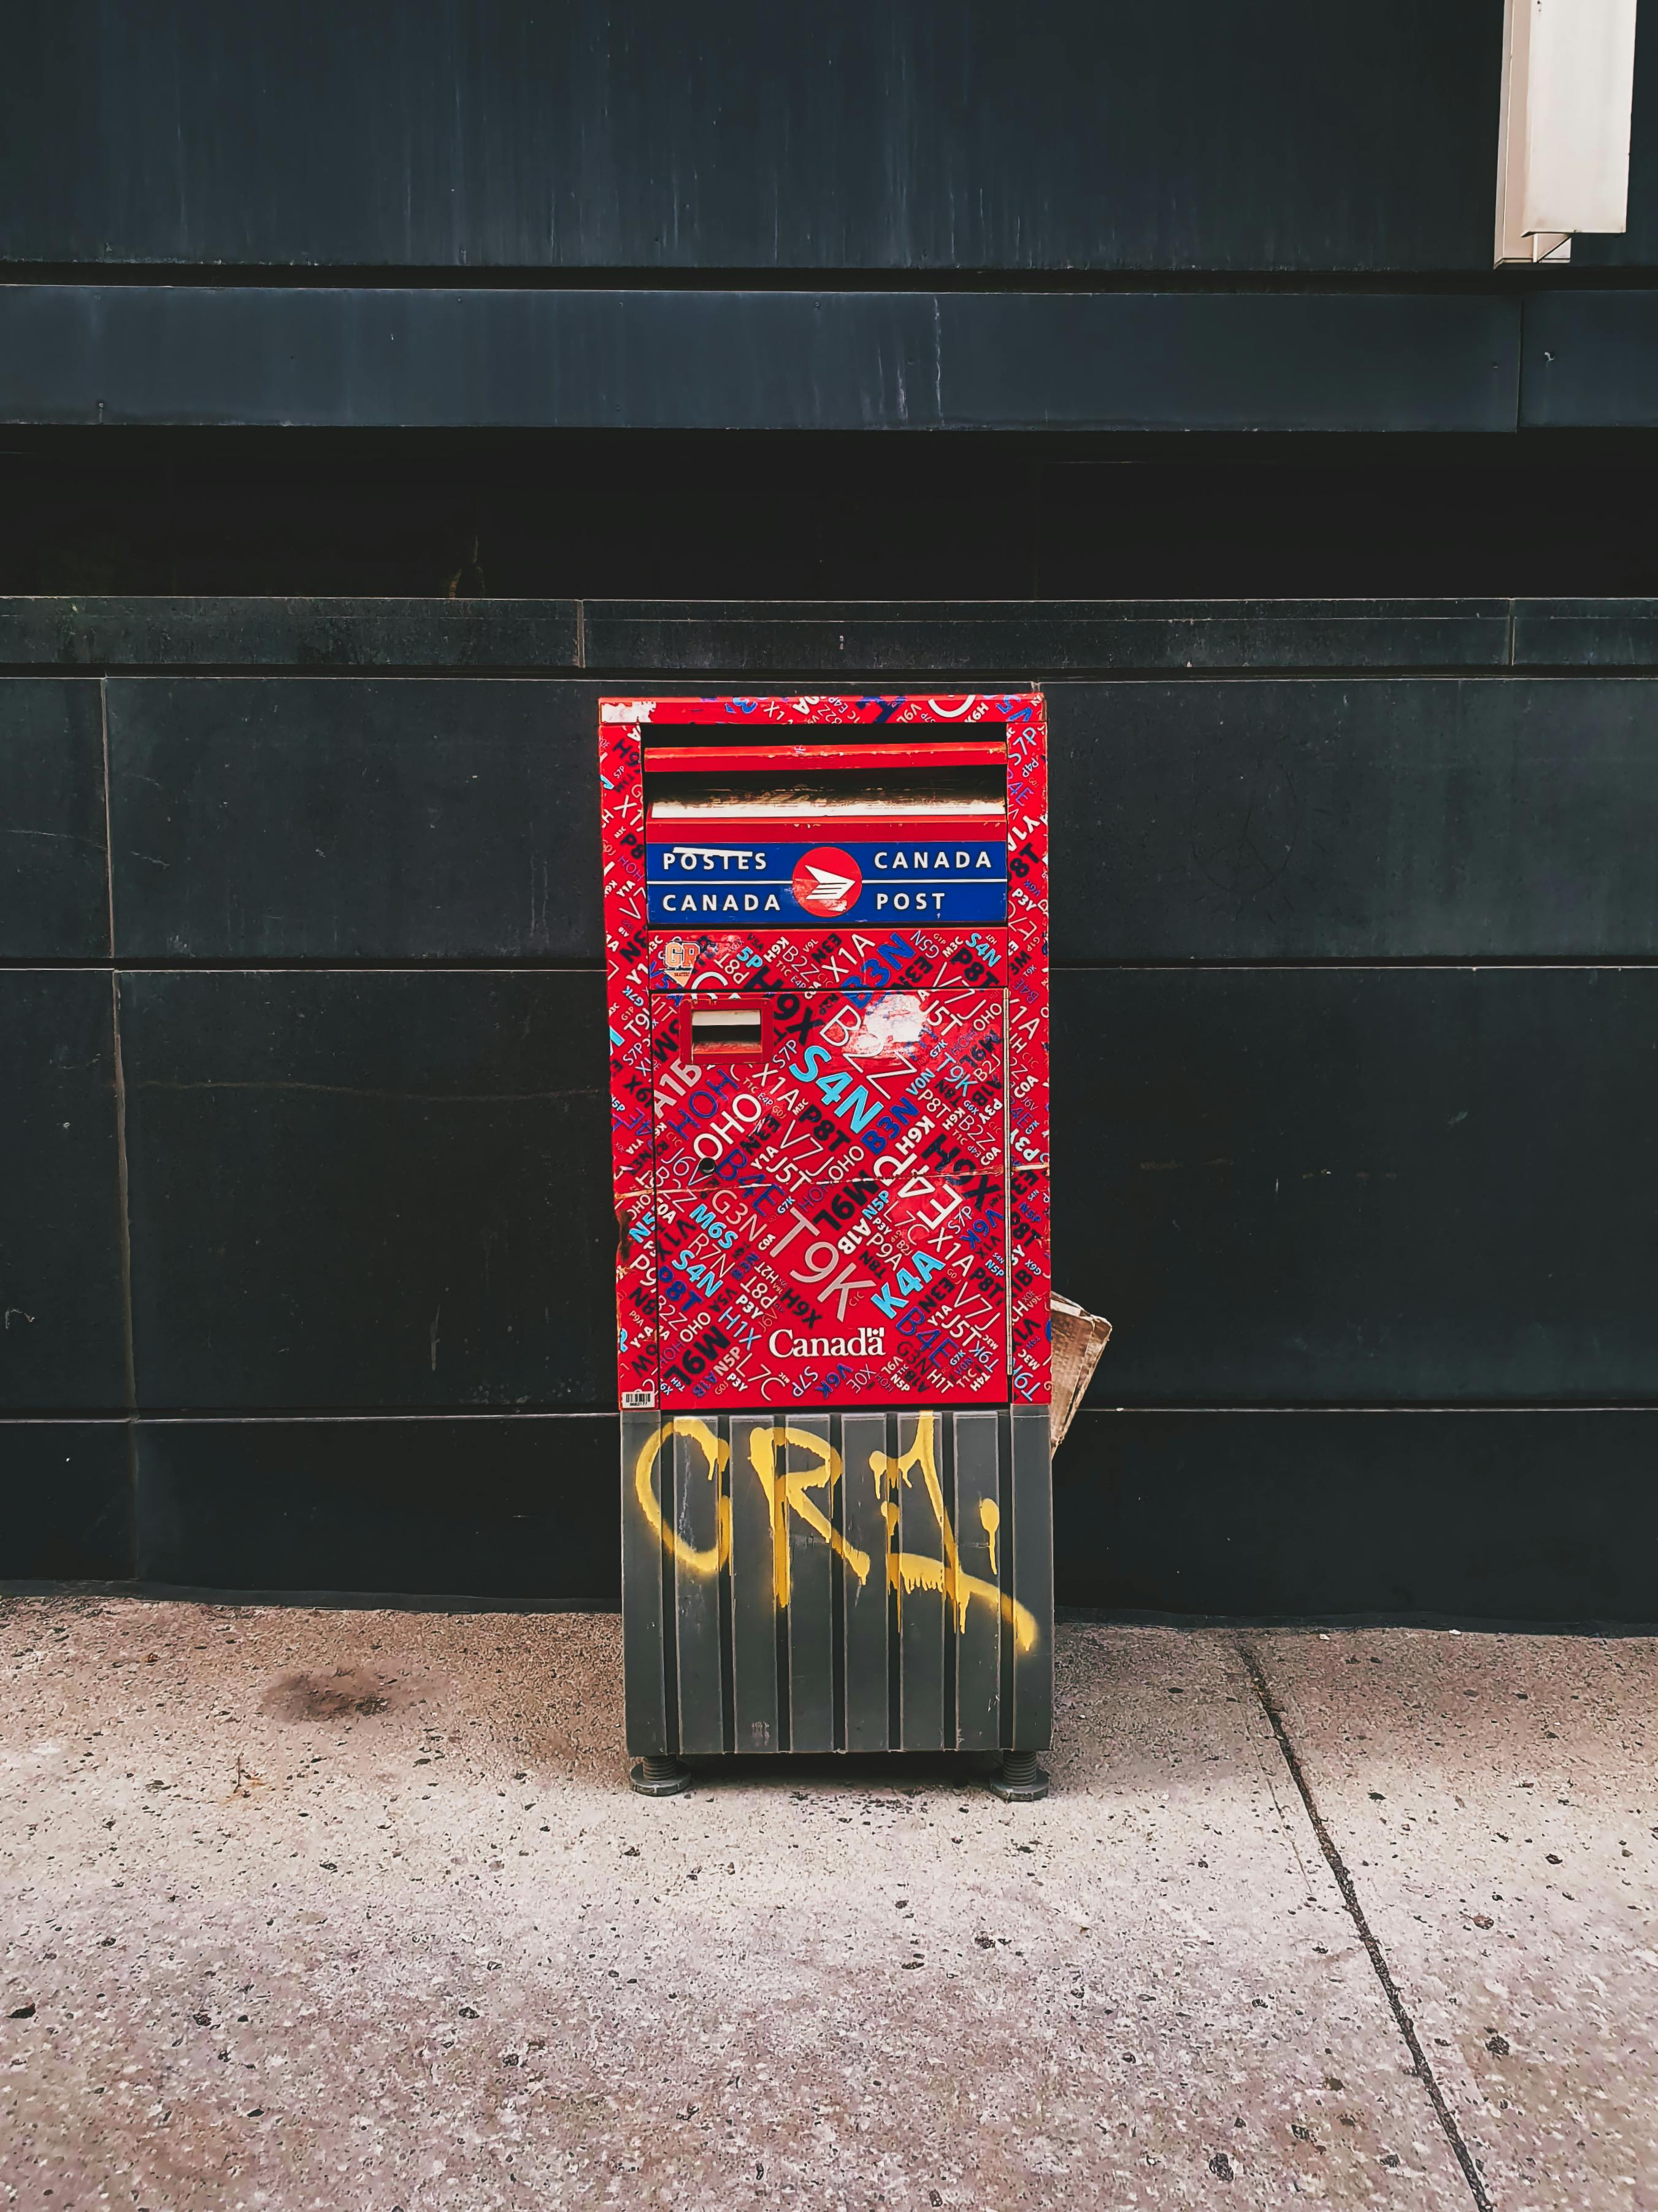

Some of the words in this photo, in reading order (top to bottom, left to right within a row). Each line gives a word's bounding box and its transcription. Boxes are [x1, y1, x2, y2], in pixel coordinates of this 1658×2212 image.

[613, 766, 625, 779] S7P
[663, 851, 766, 870] POSTES
[874, 851, 991, 869] CANADA
[662, 894, 780, 912] CANADA
[877, 893, 945, 910] POST
[1011, 888, 1038, 912] P3Y
[763, 936, 790, 962] K6H
[821, 933, 876, 983] X1A
[942, 936, 964, 958] M3C
[965, 932, 1002, 967] S4N
[782, 945, 820, 982] B2Z
[623, 1042, 643, 1066] S7P
[772, 1040, 797, 1069] S7P
[973, 1053, 1001, 1082] B2J
[654, 1058, 702, 1119] A1B
[752, 1063, 799, 1111] X1A
[789, 1045, 884, 1134] S4N
[937, 1051, 978, 1097] T9K
[792, 1098, 809, 1116] M3C
[918, 1089, 951, 1118] P8T
[942, 1107, 965, 1131] K6H
[978, 1098, 1004, 1124] P3Y
[798, 1104, 851, 1152] P8T
[860, 1097, 919, 1155] B3N
[894, 1115, 935, 1156] K6H
[958, 1115, 996, 1151] B2Z
[625, 1138, 644, 1154] Y1A
[750, 1146, 779, 1170] Y1A
[766, 1156, 812, 1192] J5T
[712, 1189, 768, 1242] G3N
[777, 1196, 796, 1214] G7K
[861, 1190, 889, 1220] N5P
[837, 1217, 872, 1254] A1B
[872, 1216, 892, 1235] P3Y
[688, 1232, 736, 1278] R7N
[769, 1207, 877, 1323] T9K
[865, 1232, 902, 1271] P9A
[927, 1227, 974, 1277] X1A
[671, 1249, 723, 1297] S4N
[969, 1266, 1004, 1299] P8T
[984, 1259, 1005, 1277] N5P
[740, 1275, 778, 1309] P8T
[870, 1250, 946, 1319] K4A
[735, 1294, 764, 1319] P3Y
[780, 1288, 823, 1329] H9X
[927, 1305, 953, 1326] Y1A
[718, 1306, 762, 1351] H1X
[769, 1327, 886, 1358] Canada
[896, 1306, 959, 1369] B4E
[941, 1314, 983, 1346] J5T
[982, 1334, 999, 1350] M3C
[713, 1346, 740, 1377] N5P
[969, 1340, 999, 1373] T9K
[1017, 1348, 1041, 1370] M3C
[726, 1372, 748, 1392] P3Y
[792, 1365, 818, 1397] S7P
[890, 1375, 911, 1391] N5P
[926, 1369, 954, 1394] H1T
[956, 1368, 977, 1388] T1C
